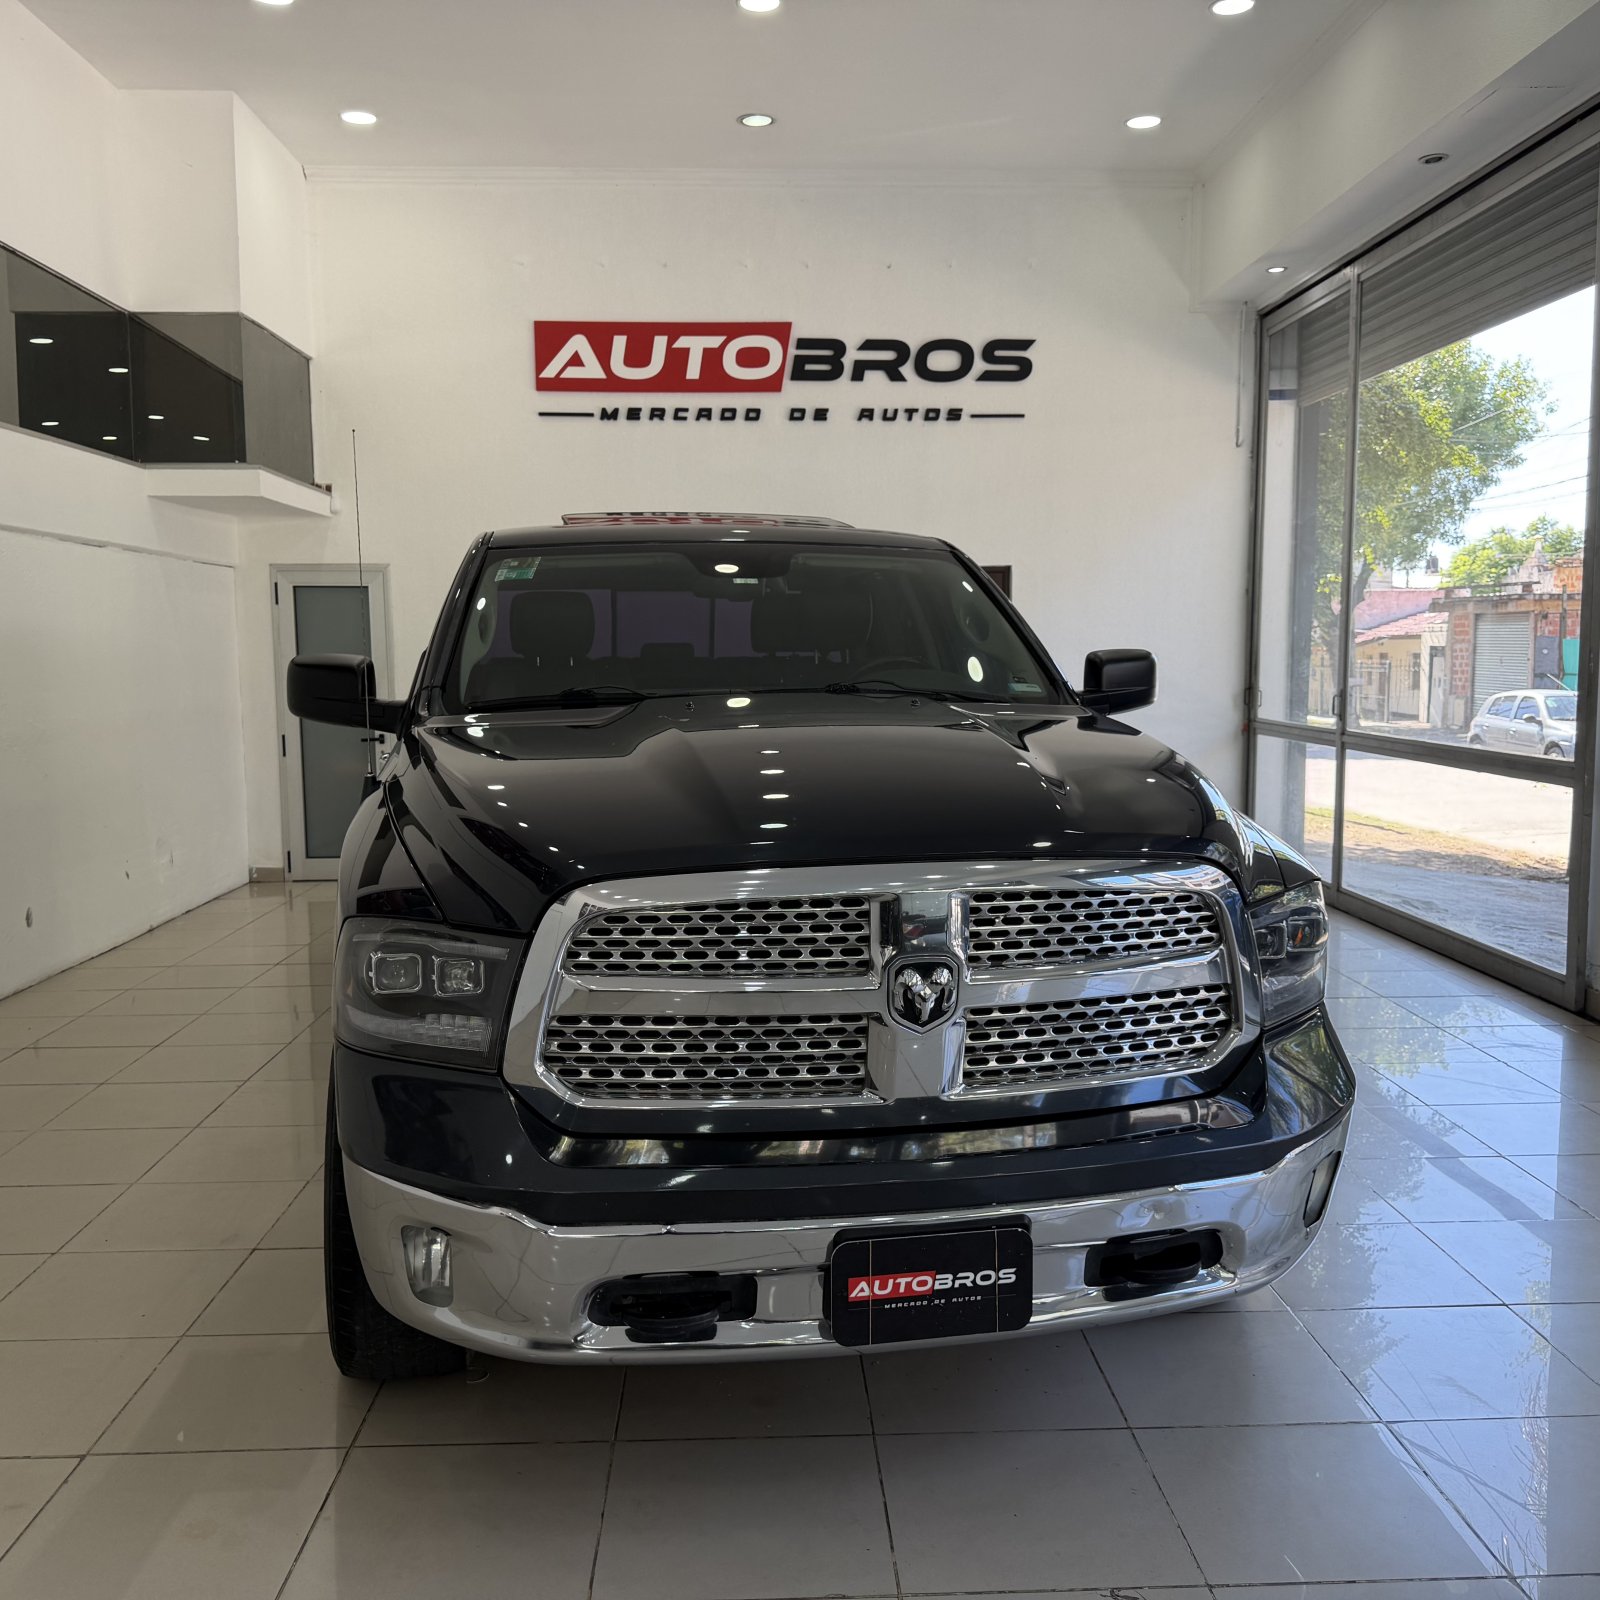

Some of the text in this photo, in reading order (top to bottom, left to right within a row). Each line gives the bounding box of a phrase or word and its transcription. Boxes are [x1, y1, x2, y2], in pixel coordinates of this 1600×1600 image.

[537, 333, 1037, 383] AUTOBROS
[599, 407, 964, 422] MERCADO DE AUTOS
[848, 1267, 1017, 1298] AUTOBROS
[884, 1300, 928, 1309] MERCADO
